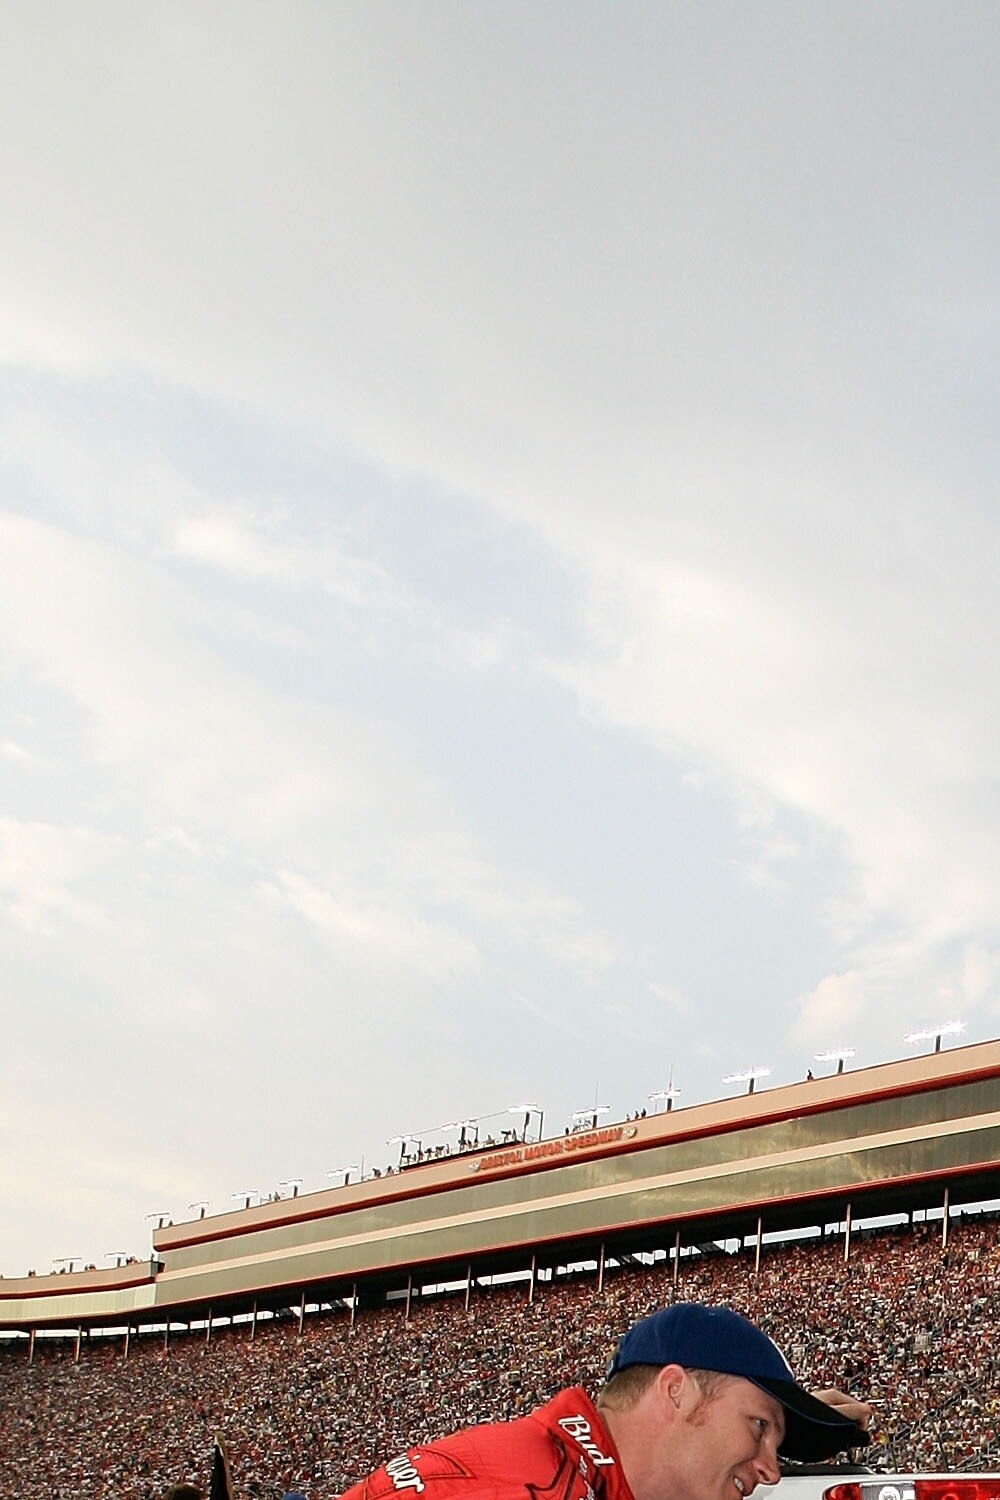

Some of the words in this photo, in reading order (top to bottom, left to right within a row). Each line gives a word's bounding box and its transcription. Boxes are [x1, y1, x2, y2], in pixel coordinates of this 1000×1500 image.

[524, 1142, 563, 1160] MOTOR
[563, 1126, 624, 1151] SPEEDWAY
[558, 1413, 614, 1467] Bud
